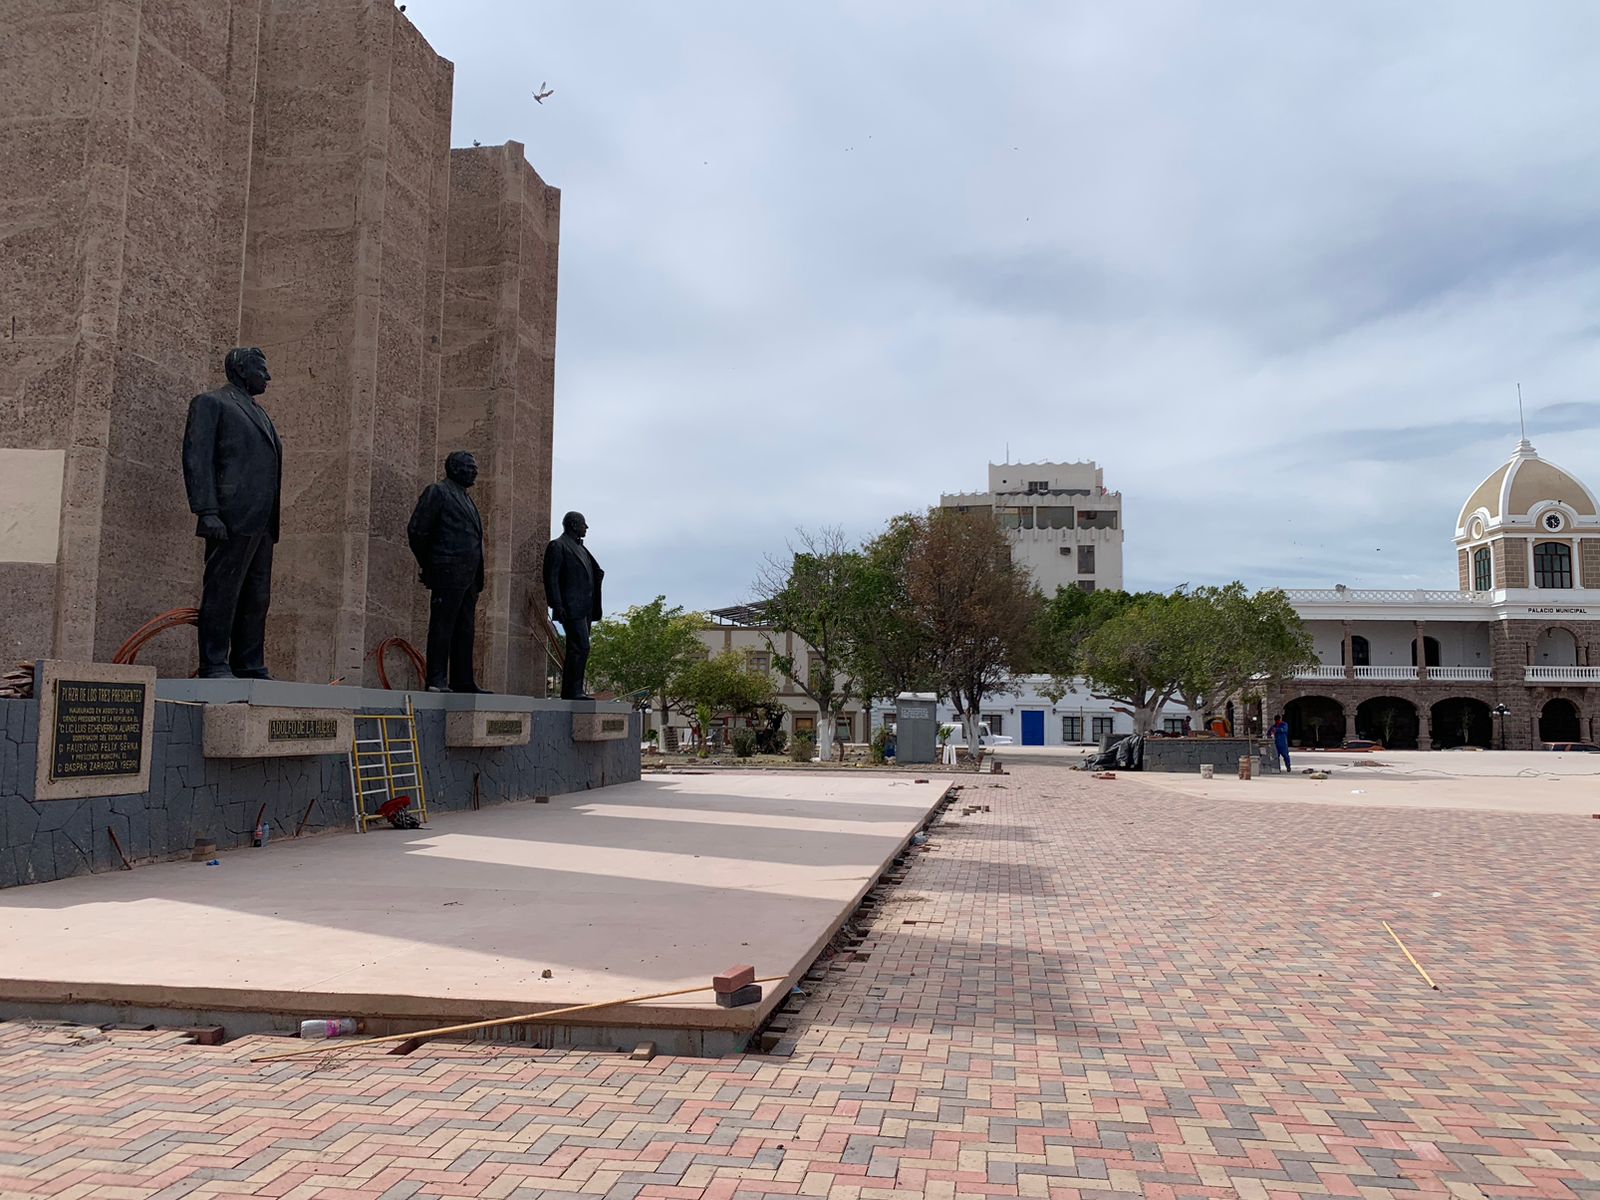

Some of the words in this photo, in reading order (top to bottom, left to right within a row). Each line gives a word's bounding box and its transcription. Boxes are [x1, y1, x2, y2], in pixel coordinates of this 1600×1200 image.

[62, 688, 79, 702] PLAZA
[80, 688, 86, 702] DE
[87, 688, 97, 702] LOS
[98, 688, 110, 702] TRES
[111, 689, 142, 702] PRESIDENTES
[271, 721, 296, 734] ADOLFO
[66, 743, 98, 752] FAUSTINO
[100, 742, 117, 752] FELIX
[64, 762, 88, 772] GASPAR
[90, 760, 118, 771] ZARAGOZA
